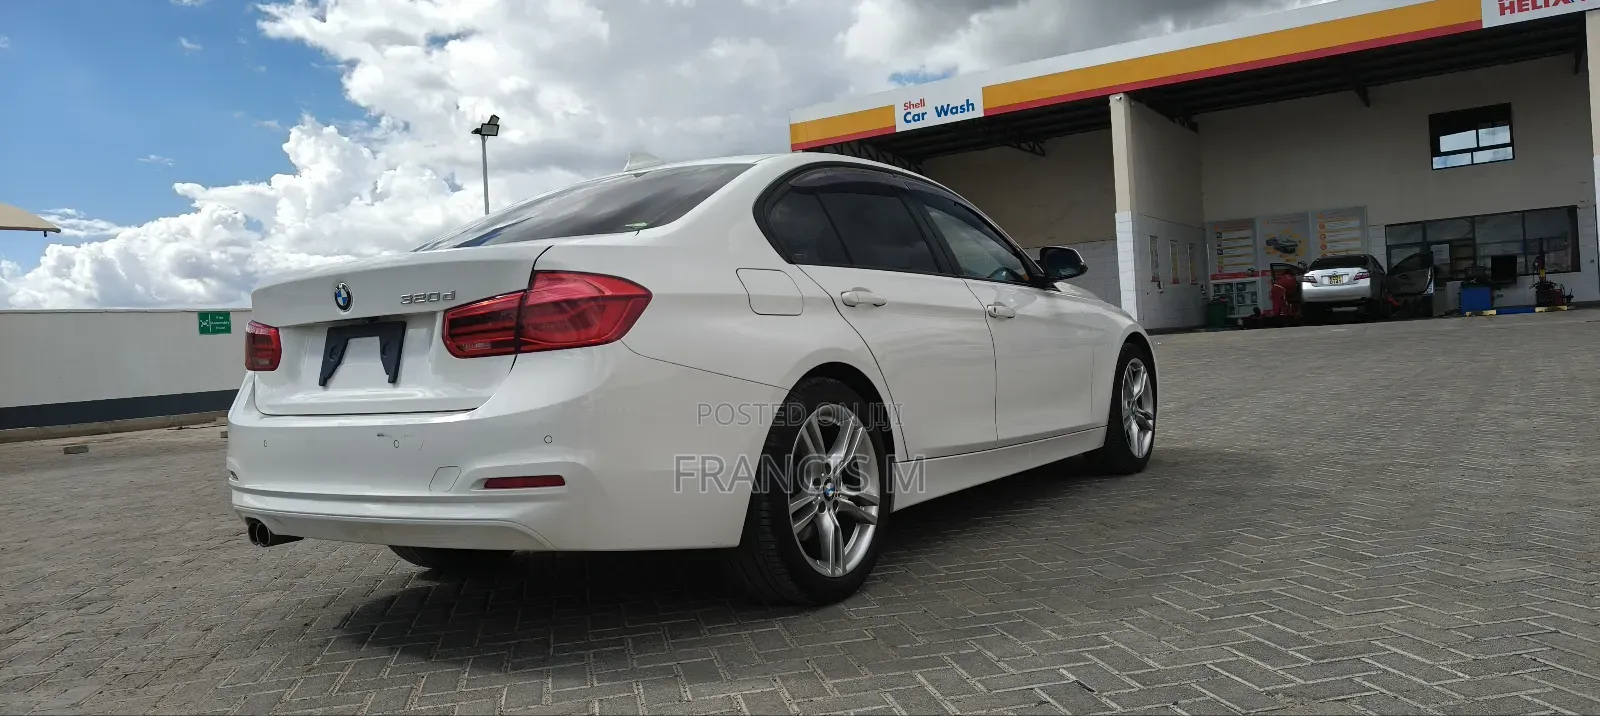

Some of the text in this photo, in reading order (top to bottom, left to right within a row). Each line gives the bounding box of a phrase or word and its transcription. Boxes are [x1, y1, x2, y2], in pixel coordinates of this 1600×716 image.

[903, 98, 926, 111] Shell
[903, 99, 975, 124] Car Wash
